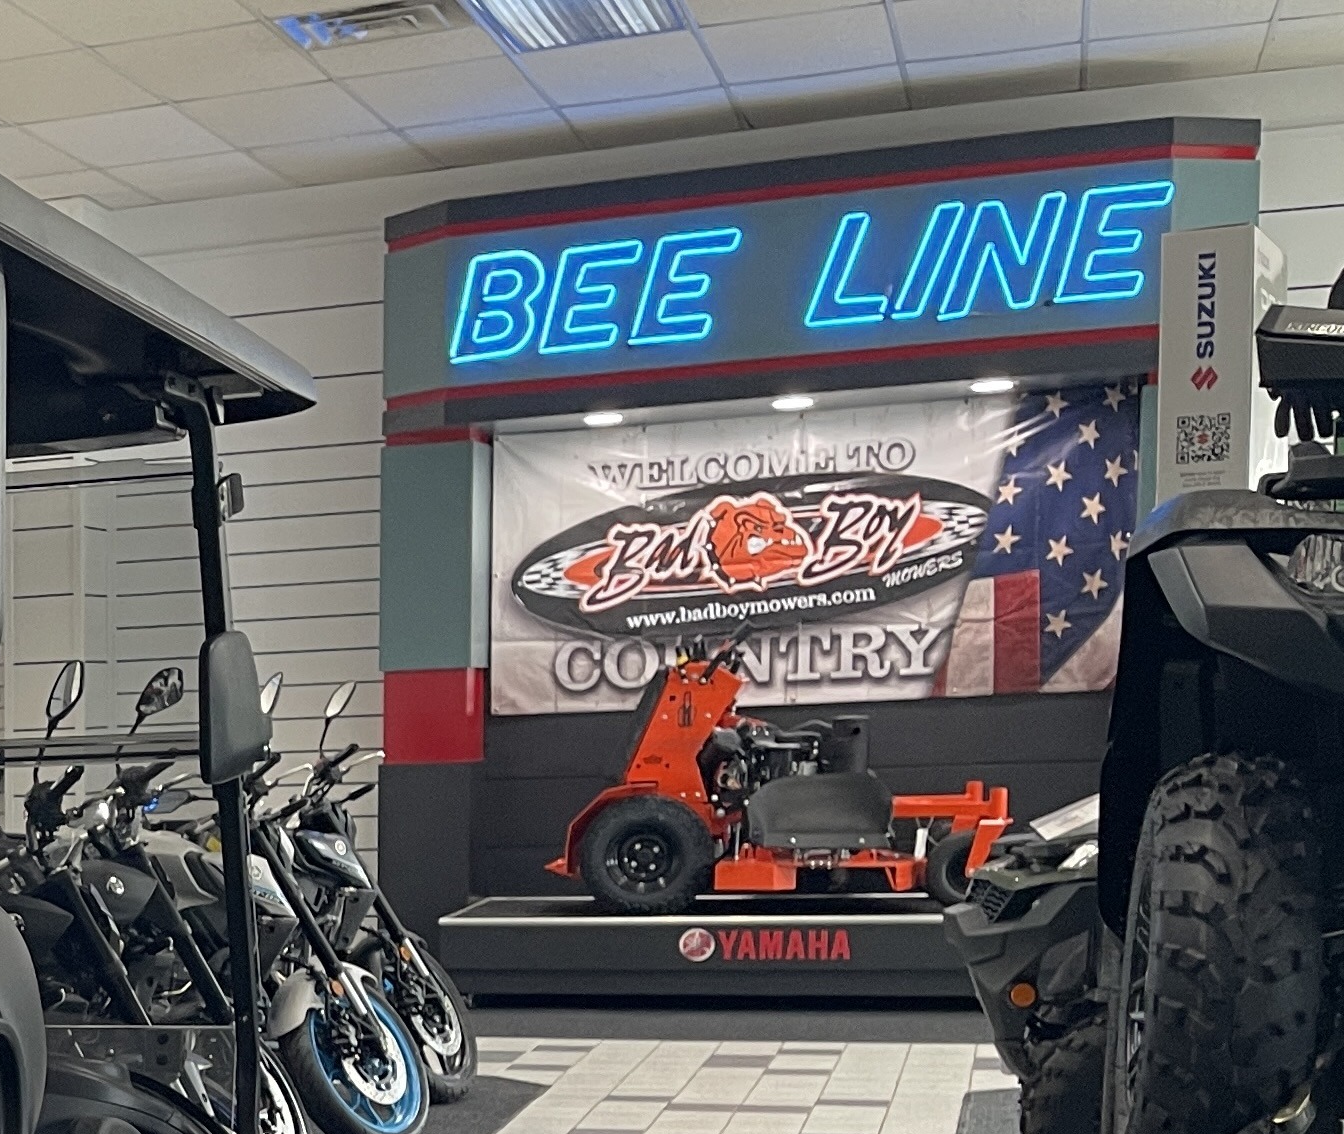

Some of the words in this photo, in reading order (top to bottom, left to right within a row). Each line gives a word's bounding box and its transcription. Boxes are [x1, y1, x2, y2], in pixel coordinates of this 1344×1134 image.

[450, 226, 742, 365] BEE
[804, 180, 1175, 328] LINE
[1195, 252, 1217, 360] SUZUKI
[588, 442, 834, 490] WELCOME
[844, 437, 916, 472] TO
[579, 508, 715, 613] Bad
[796, 490, 921, 587] Boy
[881, 549, 964, 588] MOWERS
[626, 586, 876, 630] www.badboymowers.com
[554, 623, 944, 692] CONTRY
[717, 928, 851, 961] YAMAHA
